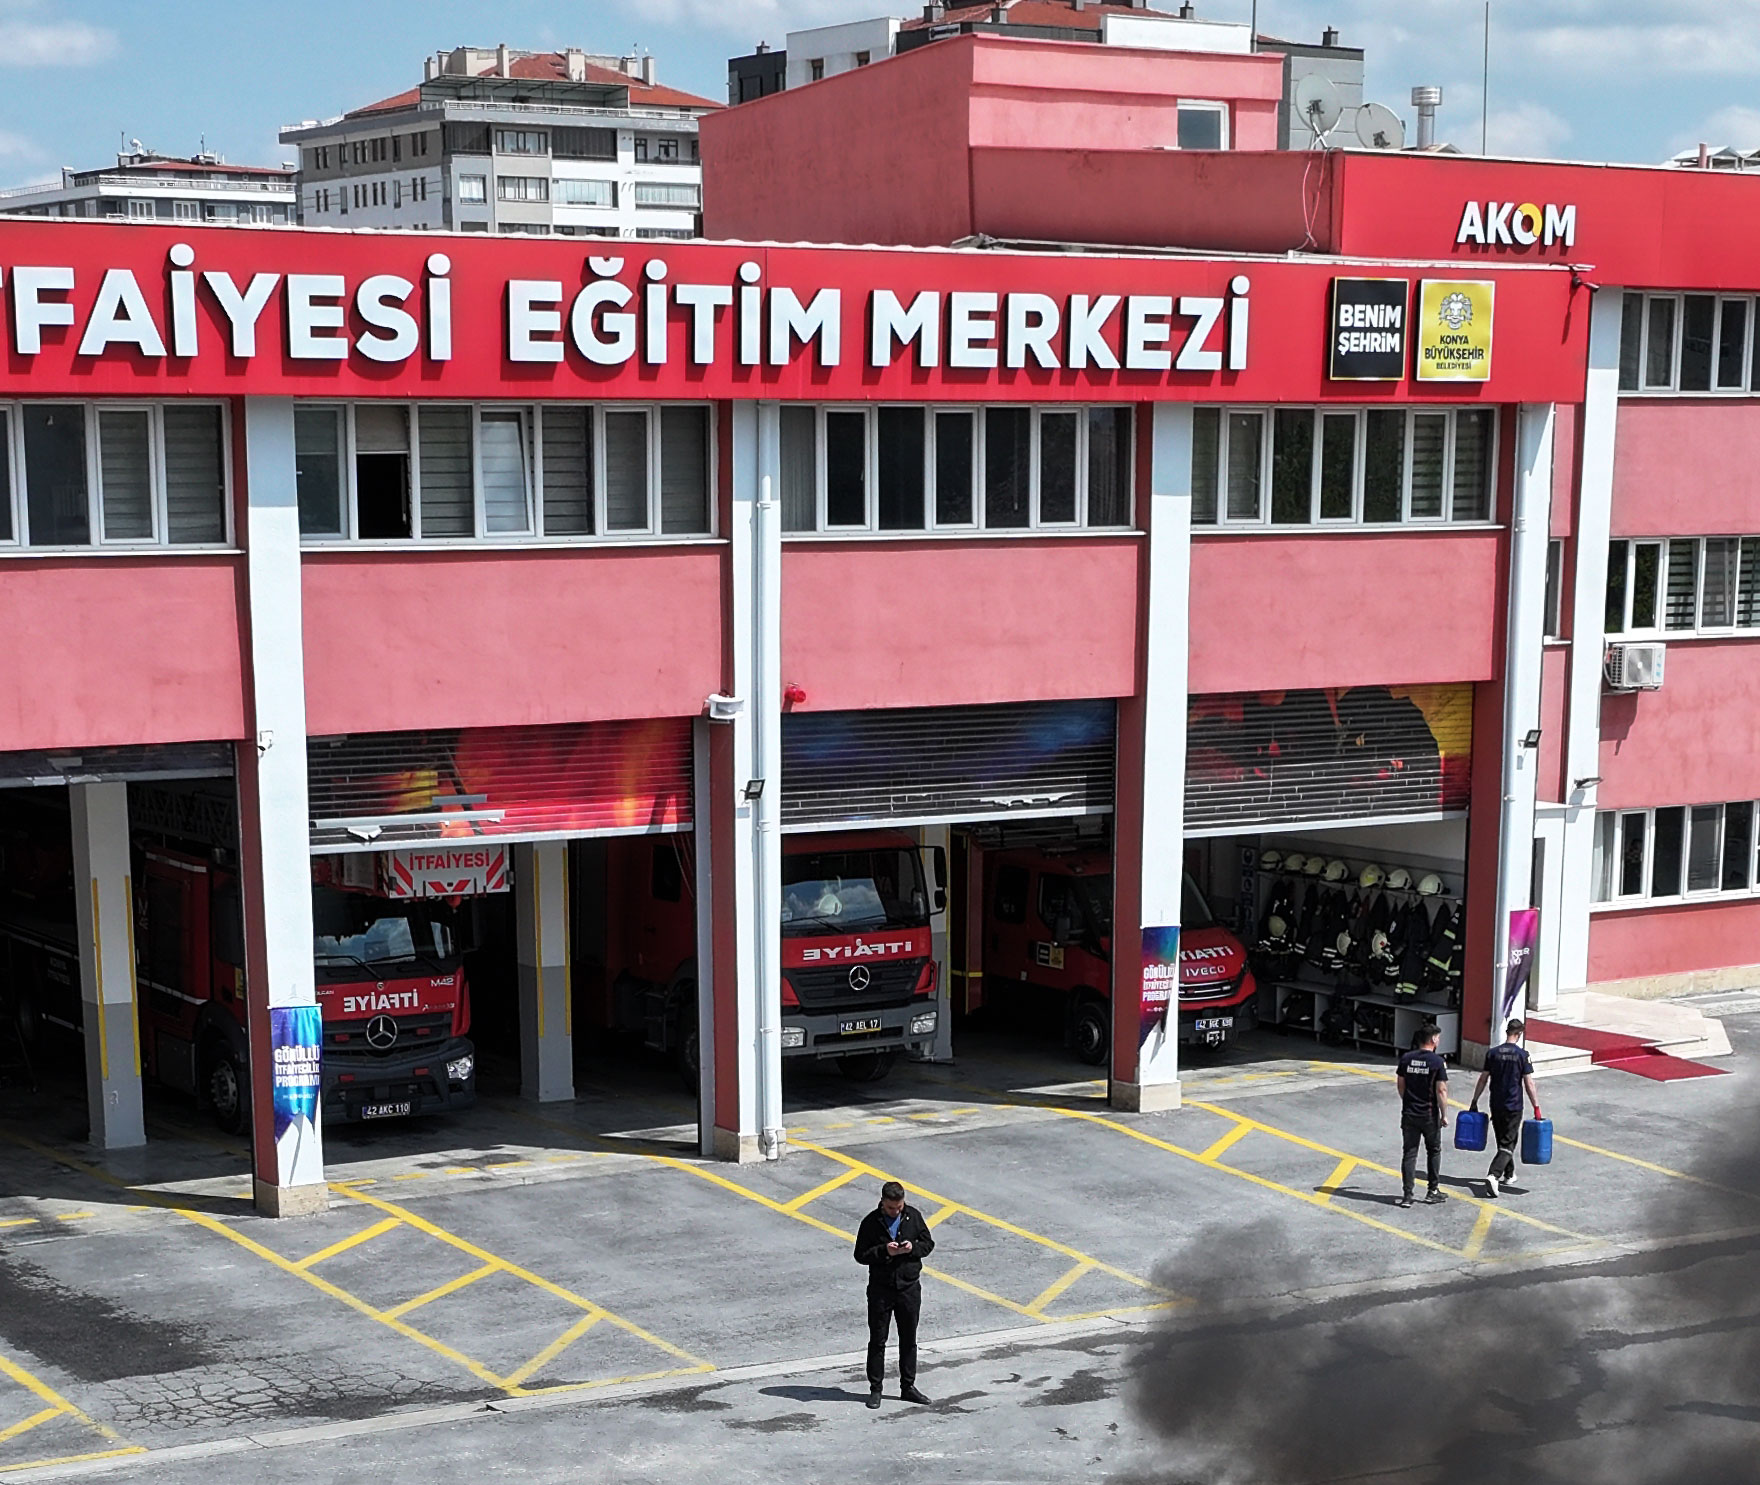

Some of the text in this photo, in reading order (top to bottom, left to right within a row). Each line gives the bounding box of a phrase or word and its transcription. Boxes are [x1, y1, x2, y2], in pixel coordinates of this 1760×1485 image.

[1457, 202, 1576, 246] AKOM
[510, 256, 840, 366] EĞİTİM
[873, 276, 1250, 370] MERKEZİ
[1339, 304, 1402, 328] BENİM
[1338, 331, 1400, 355] ŞEHRİM
[1440, 335, 1469, 345] KONYA
[1424, 346, 1484, 361] BÜYÜKŞEHİR
[409, 848, 490, 871] İTFAİYESİ
[1185, 964, 1226, 977] IVECO
[845, 1022, 853, 1031] 42
[367, 1105, 377, 1115] 42
